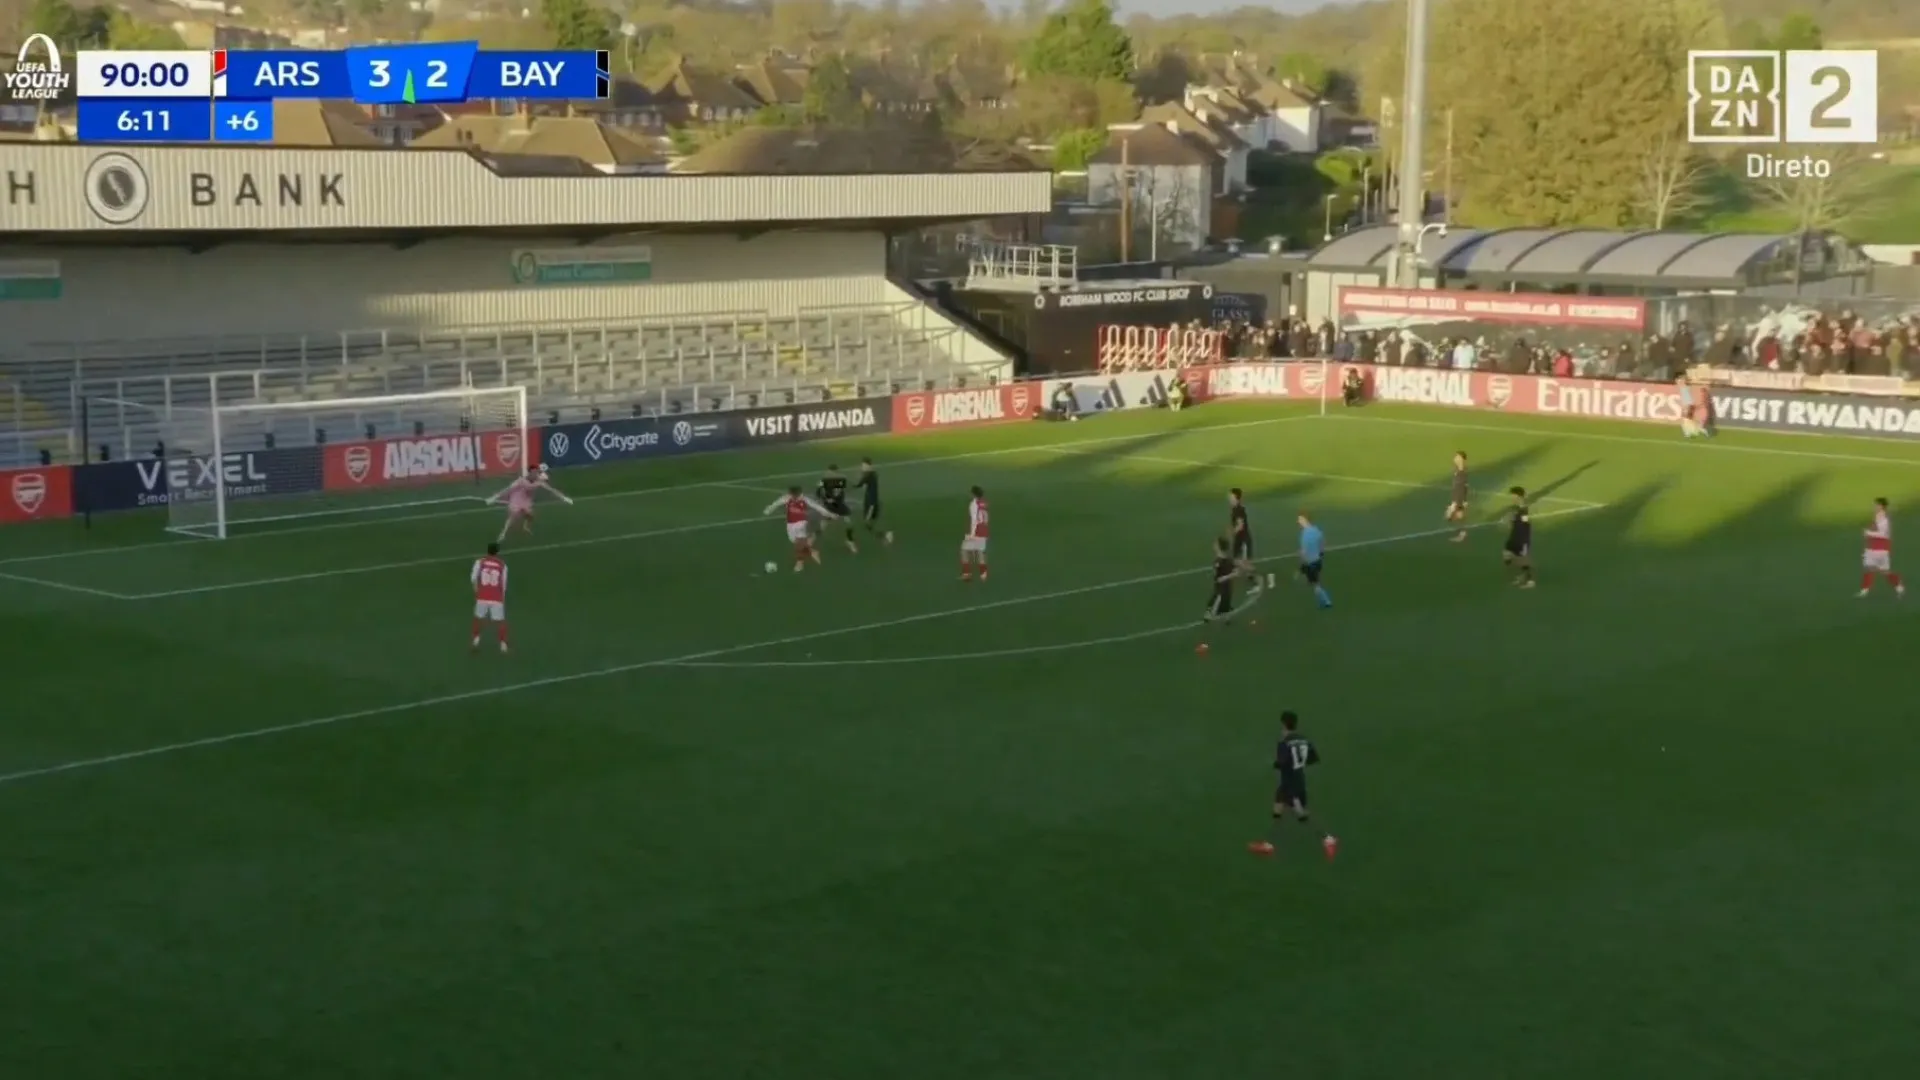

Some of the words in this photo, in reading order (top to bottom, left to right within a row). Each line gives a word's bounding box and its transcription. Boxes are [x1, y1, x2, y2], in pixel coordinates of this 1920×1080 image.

[190, 173, 345, 207] BANK
[1103, 291, 1132, 304] WOOD
[1208, 366, 1289, 395] ARSENAL
[1375, 366, 1475, 406] ARSENAL
[1537, 377, 1683, 421] Emirates
[746, 412, 793, 437] VISIT
[797, 406, 876, 433] RWANDA
[932, 387, 1005, 424] ARSENAL
[1712, 396, 1784, 422] VISIT
[1787, 400, 1920, 434] RWANDA
[383, 435, 487, 480] ARSENAL
[600, 431, 660, 451] Citygate
[136, 452, 267, 491] VEXEL
